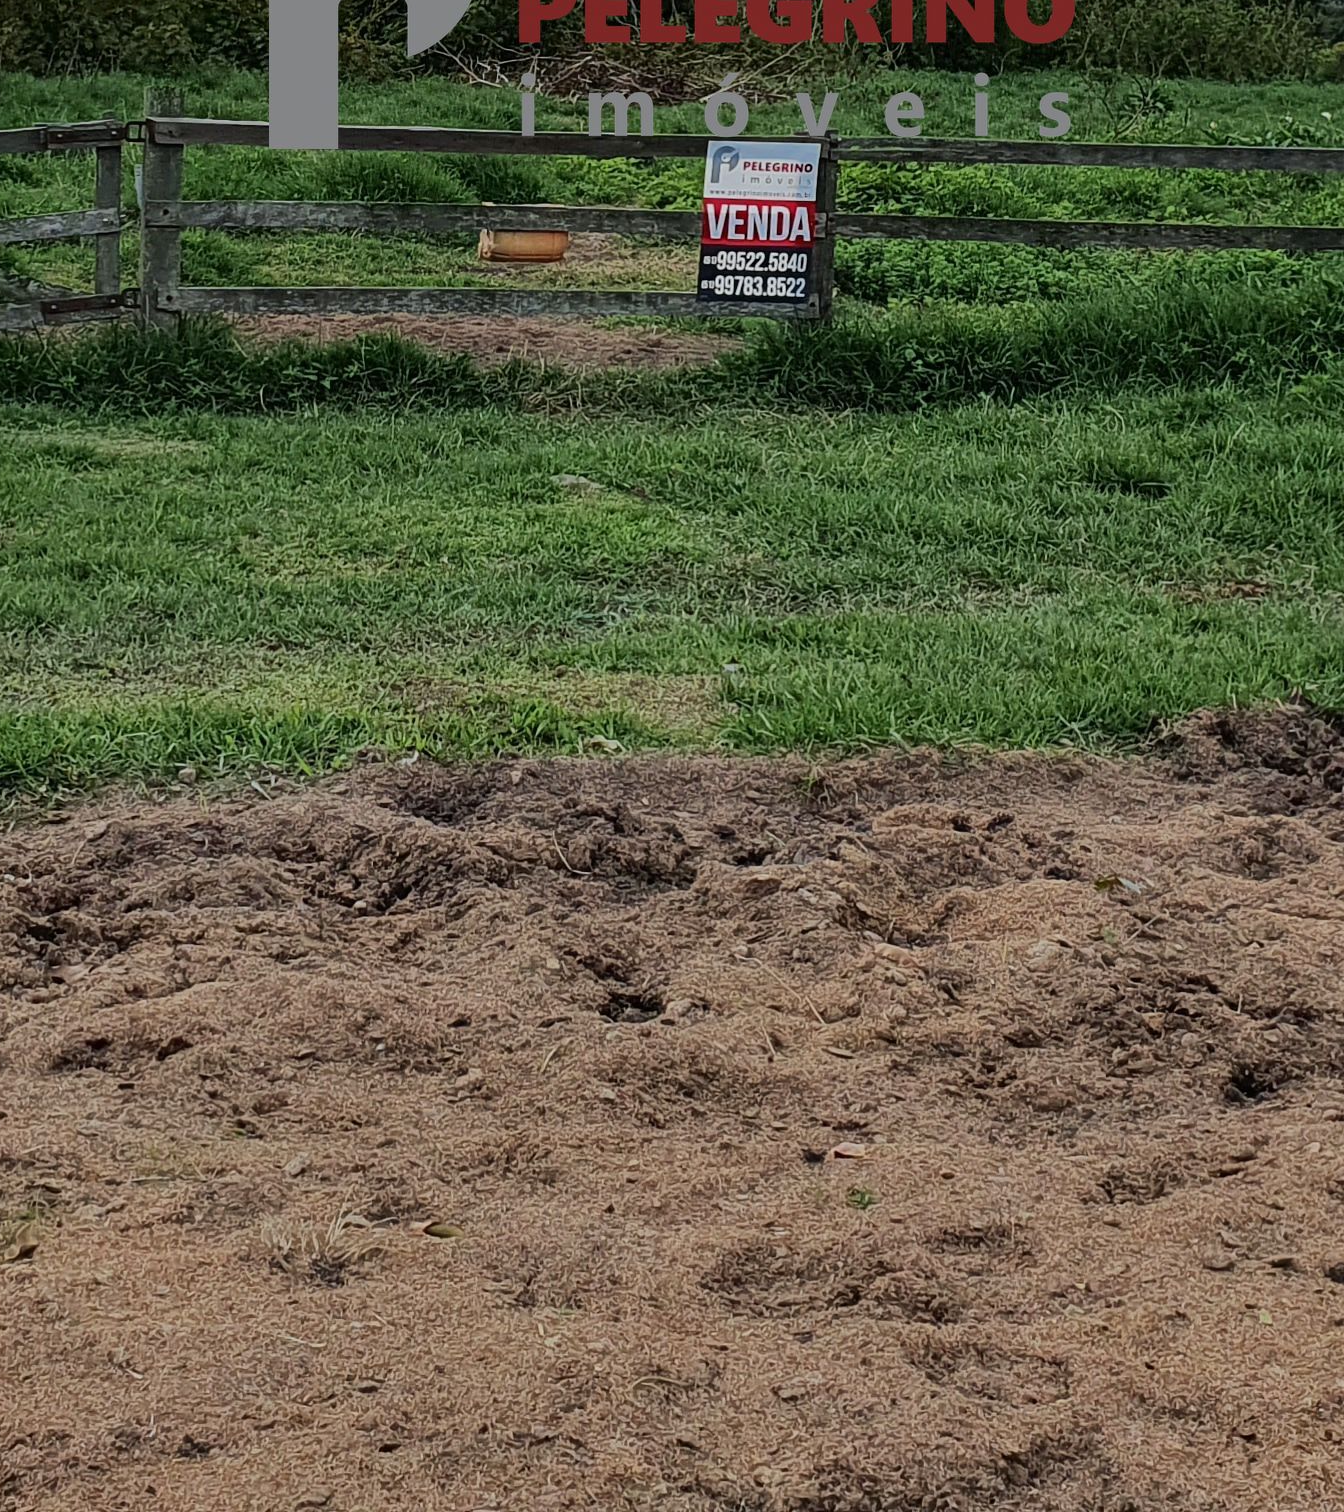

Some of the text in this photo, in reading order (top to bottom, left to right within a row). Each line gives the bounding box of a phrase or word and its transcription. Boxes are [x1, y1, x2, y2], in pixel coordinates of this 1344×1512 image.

[743, 161, 813, 173] PELEGRINO
[742, 175, 812, 186] imóveis
[706, 203, 811, 242] VENDA
